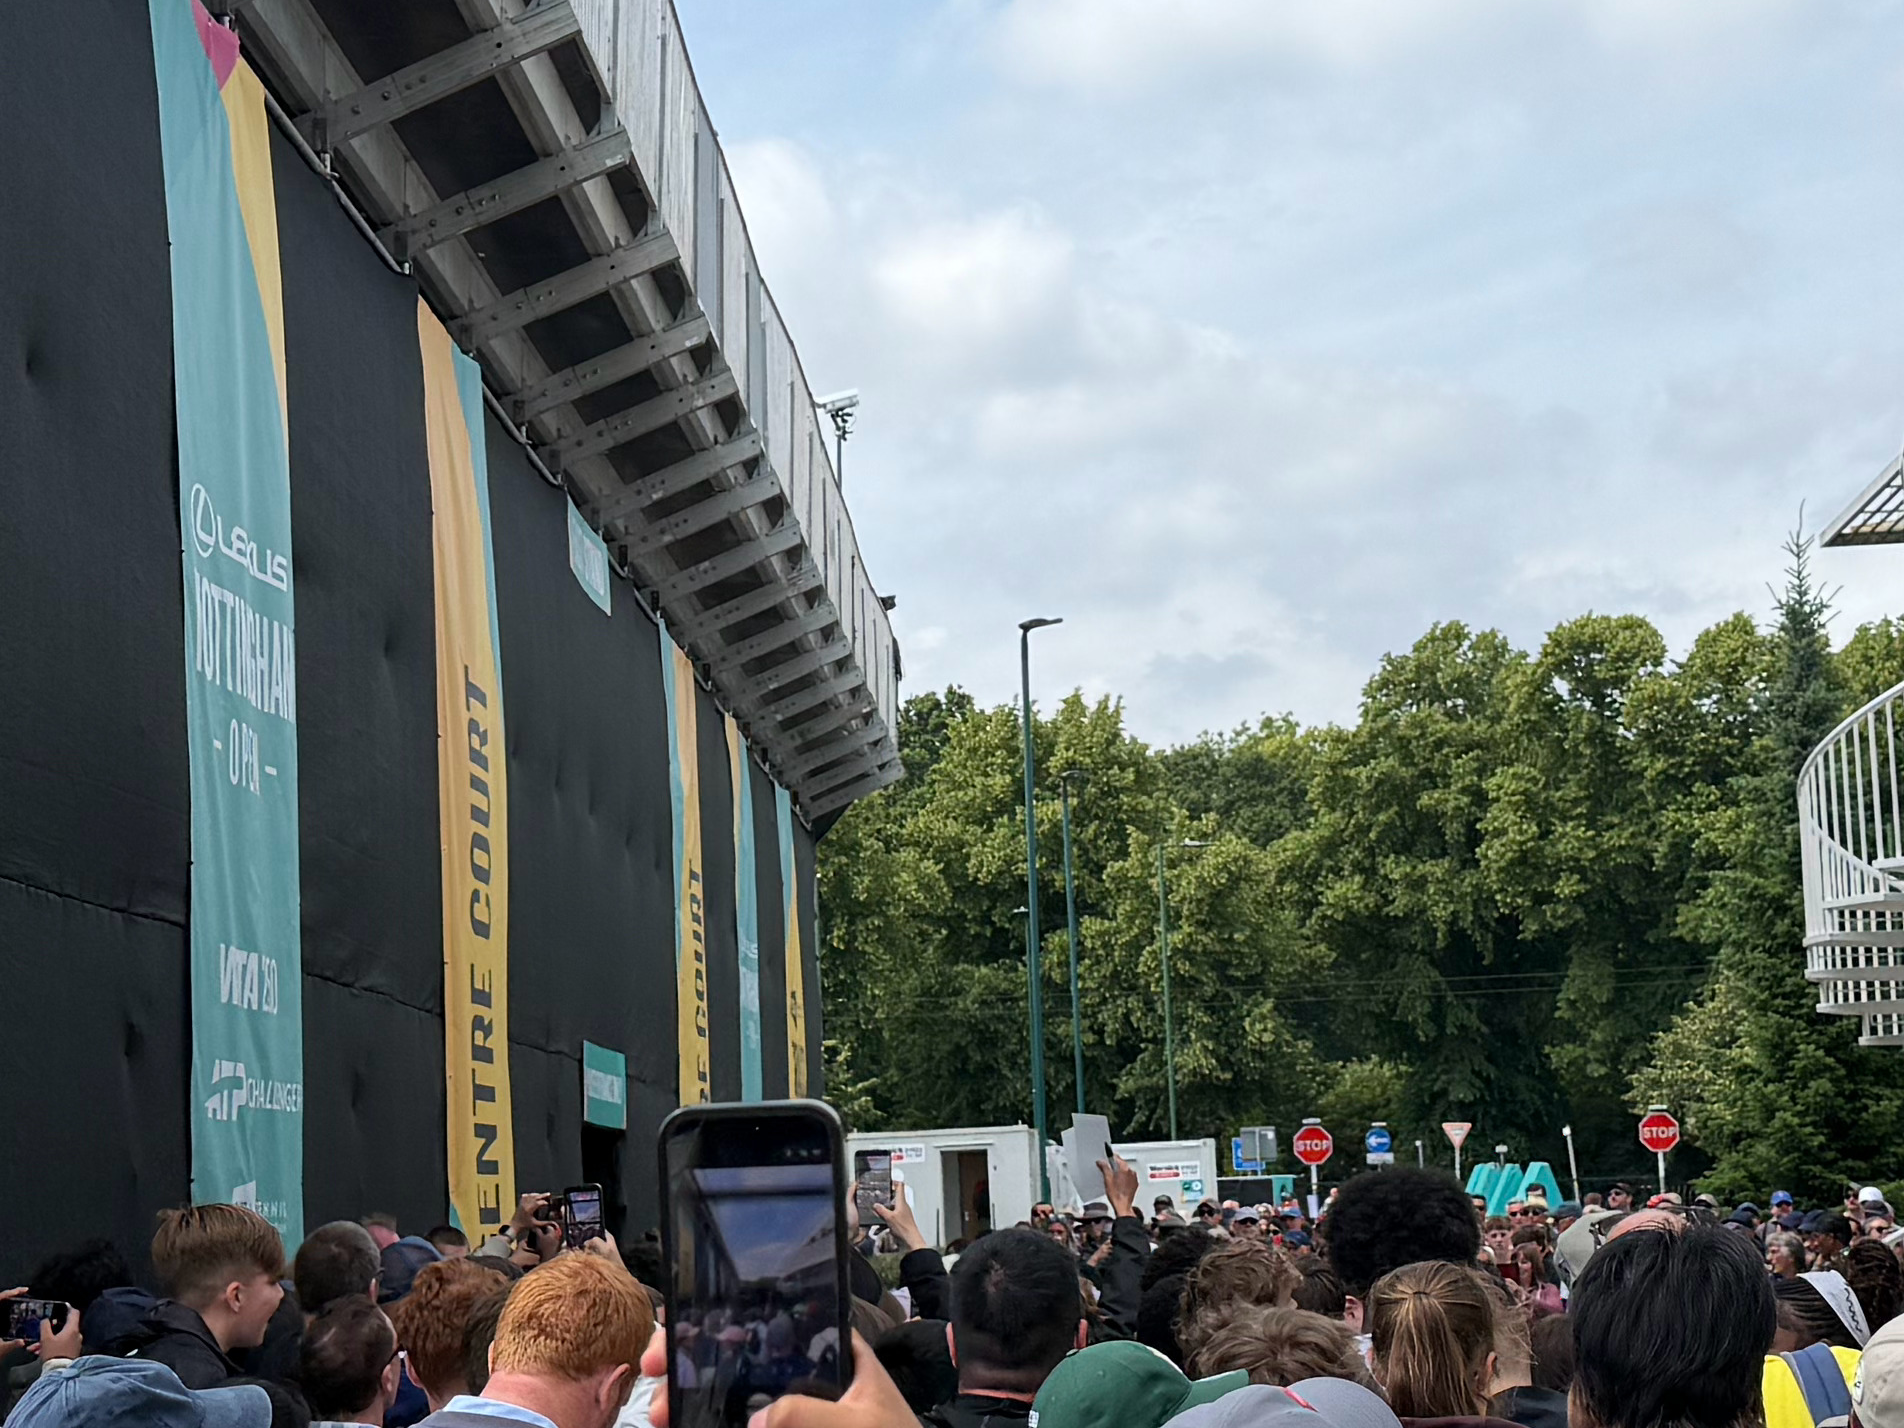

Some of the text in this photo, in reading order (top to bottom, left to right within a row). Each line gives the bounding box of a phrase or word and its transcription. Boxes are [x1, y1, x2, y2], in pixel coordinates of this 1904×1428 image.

[465, 664, 493, 940] COURT
[1643, 1125, 1677, 1140] STOP
[1296, 1139, 1330, 1153] STOP
